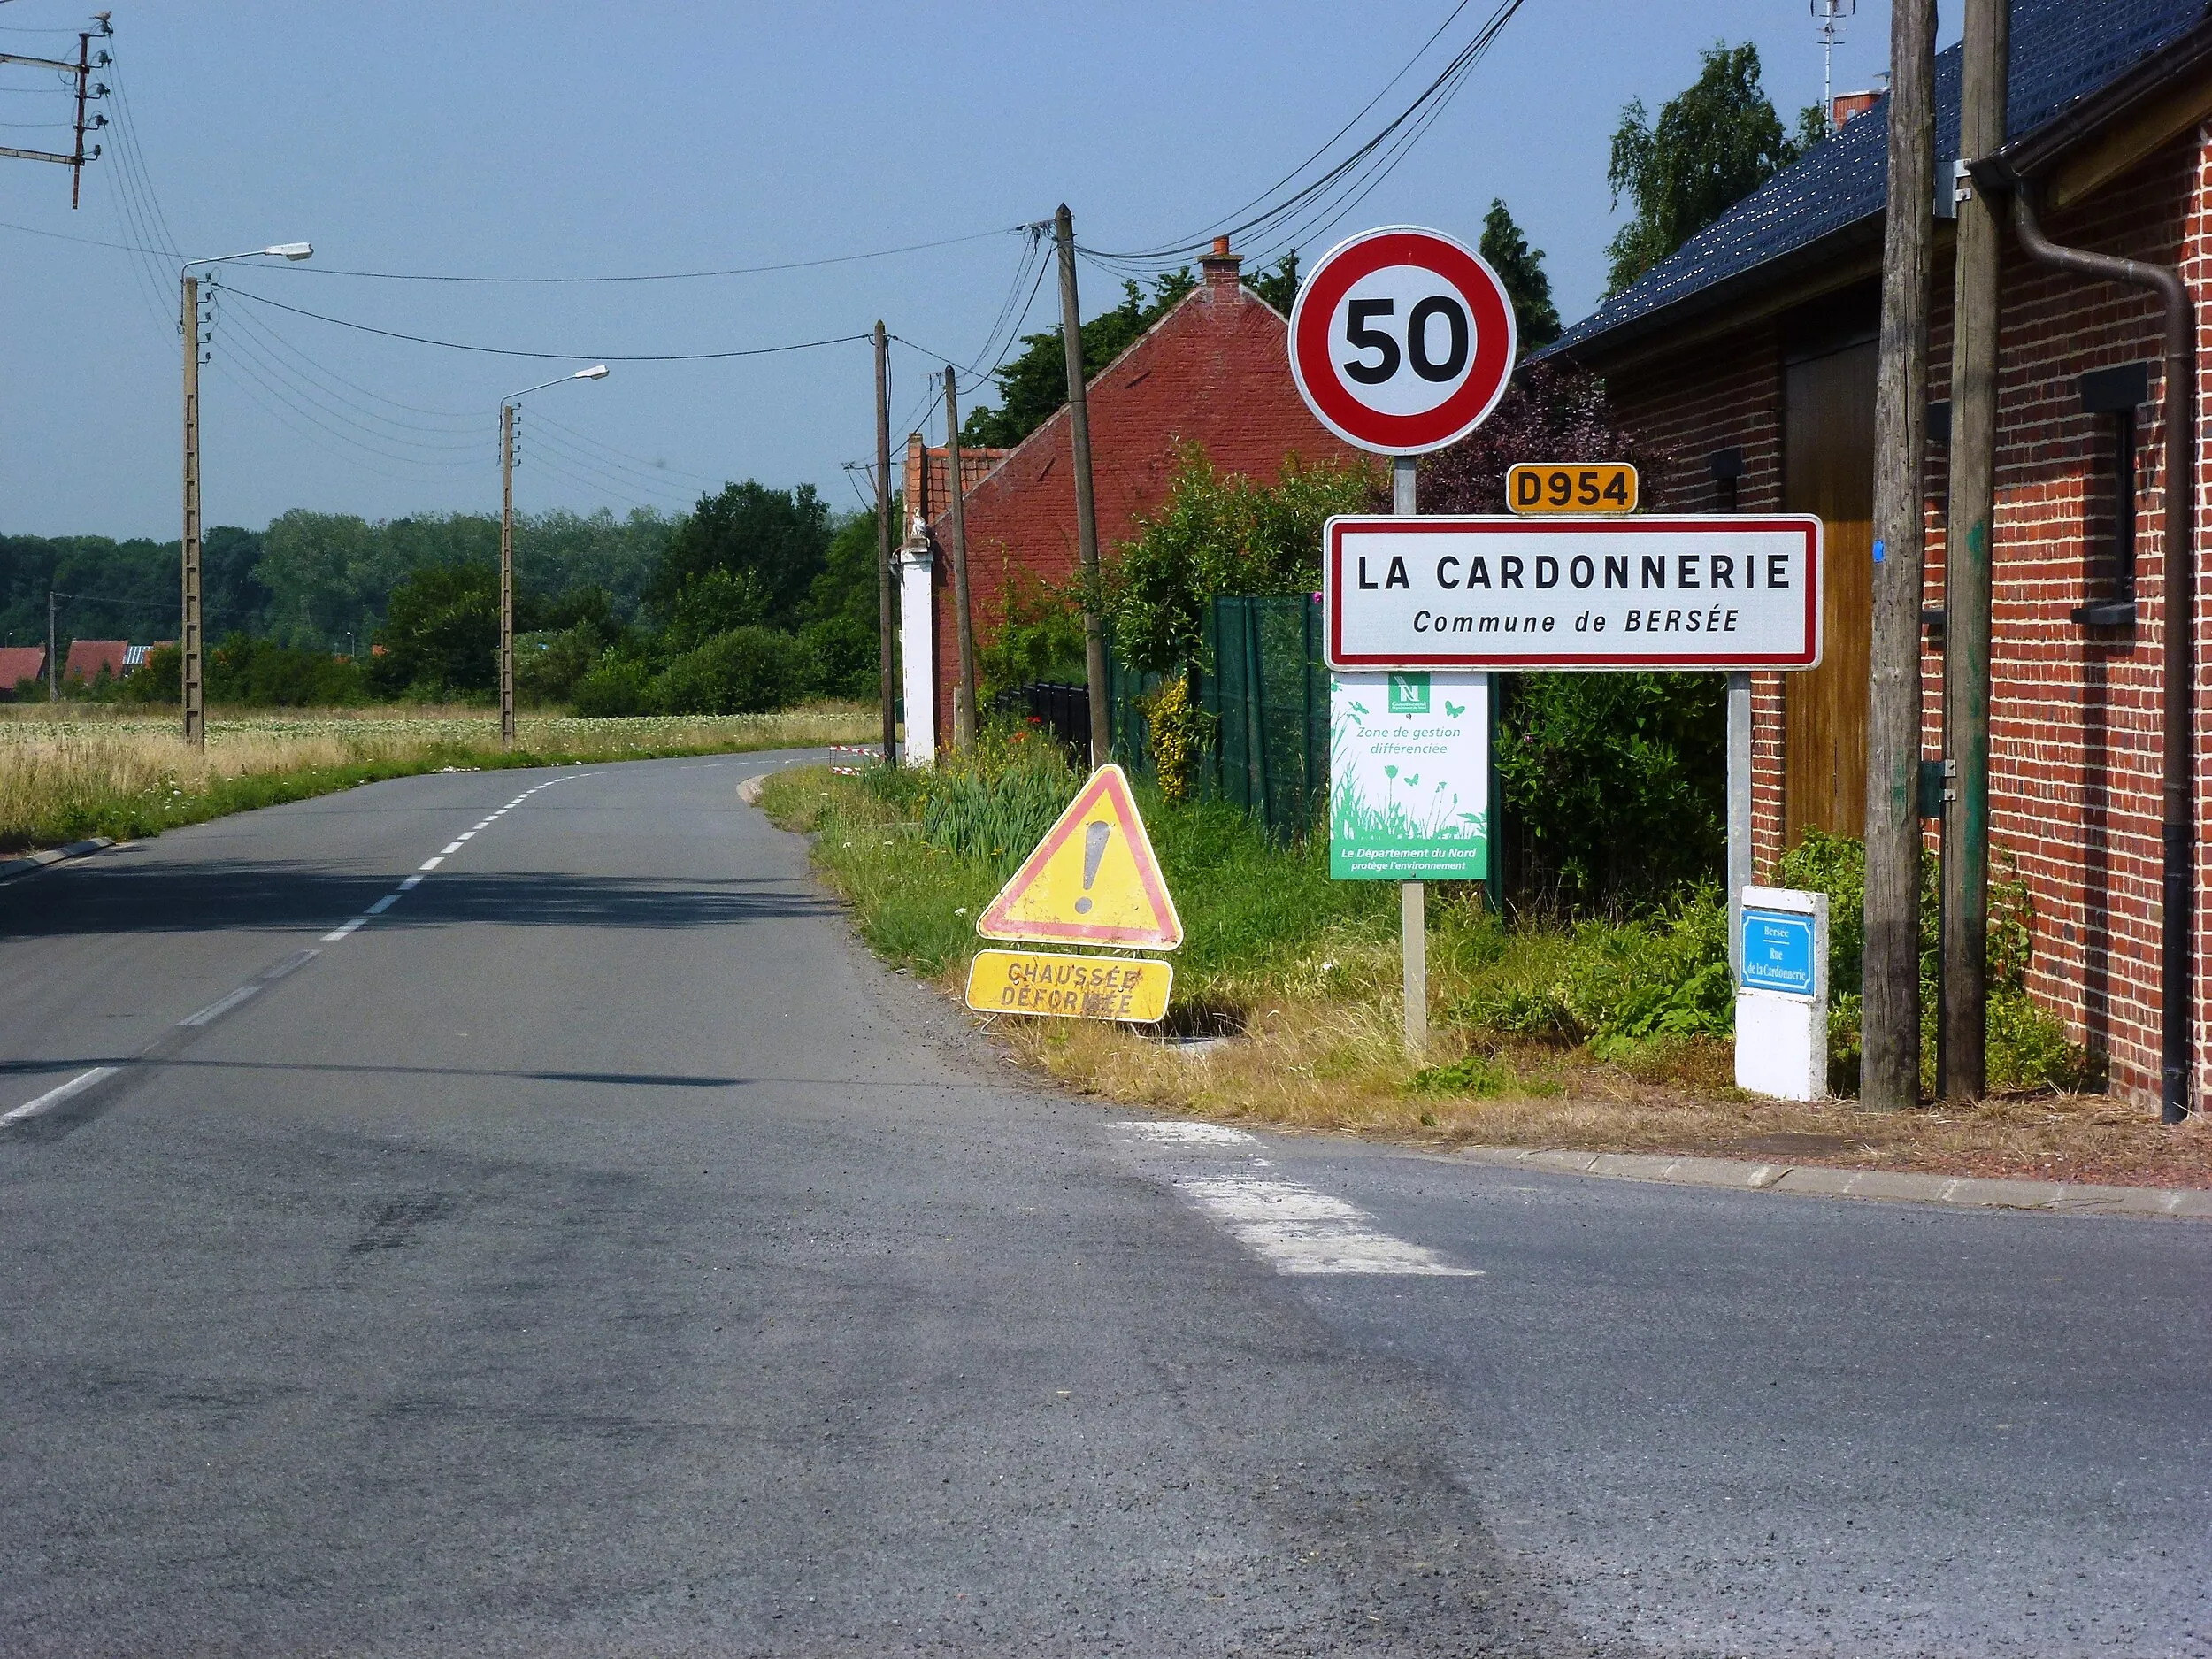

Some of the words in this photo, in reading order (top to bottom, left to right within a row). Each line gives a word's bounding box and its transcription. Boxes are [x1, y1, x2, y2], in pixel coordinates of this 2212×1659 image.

[1343, 296, 1469, 385] 50
[1517, 472, 1629, 506] D954
[1359, 556, 1410, 590] LA
[1437, 554, 1791, 590] CARDONNERIE
[1413, 610, 1555, 633] Commune
[1575, 610, 1606, 633] de
[1625, 603, 1740, 633] BERSÉE
[1357, 726, 1389, 737] Zone
[1393, 726, 1409, 737] de
[1413, 726, 1461, 741] gestion
[1371, 743, 1448, 754] différenciée
[1341, 849, 1353, 858] Le
[1356, 847, 1428, 862] Département
[1431, 848, 1445, 858] du
[1448, 848, 1476, 858] Nord
[1351, 861, 1387, 872] protège
[1764, 926, 1788, 937] Bersée
[1770, 948, 1783, 960] Rue
[1008, 962, 1138, 989] CHAUSSÉE
[1747, 962, 1756, 974] de
[1756, 963, 1763, 974] la
[1763, 964, 1806, 980] Cardonnerie
